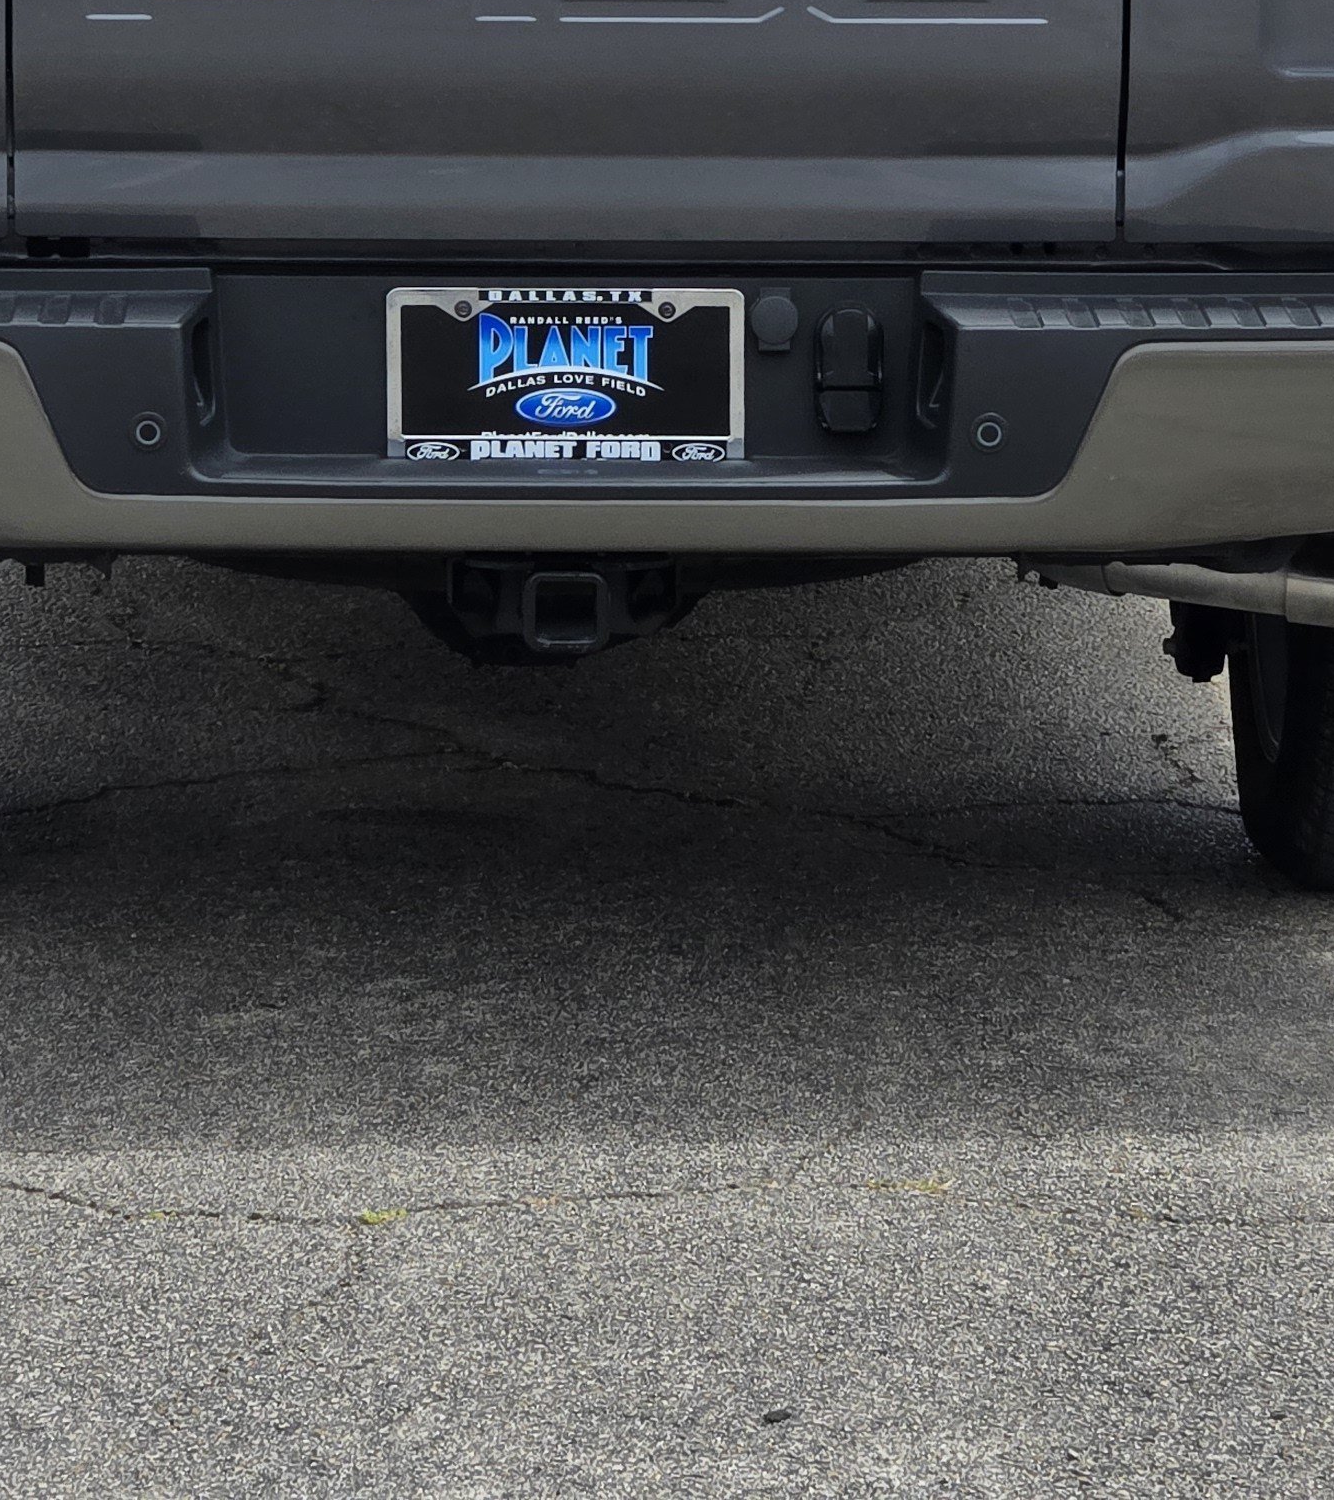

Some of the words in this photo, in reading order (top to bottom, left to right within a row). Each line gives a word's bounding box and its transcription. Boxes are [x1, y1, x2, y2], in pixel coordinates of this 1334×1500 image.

[509, 316, 570, 325] RANDALL
[575, 316, 623, 325] REED'S
[478, 312, 654, 384] PLANET
[485, 376, 546, 399] DALLAS
[553, 374, 595, 386] LOVE
[601, 377, 647, 398] FIELD
[535, 393, 597, 419] Ford
[417, 444, 450, 460] Ford
[470, 440, 577, 461] PLANET
[585, 441, 662, 462] FORD
[682, 444, 715, 461] Ford
